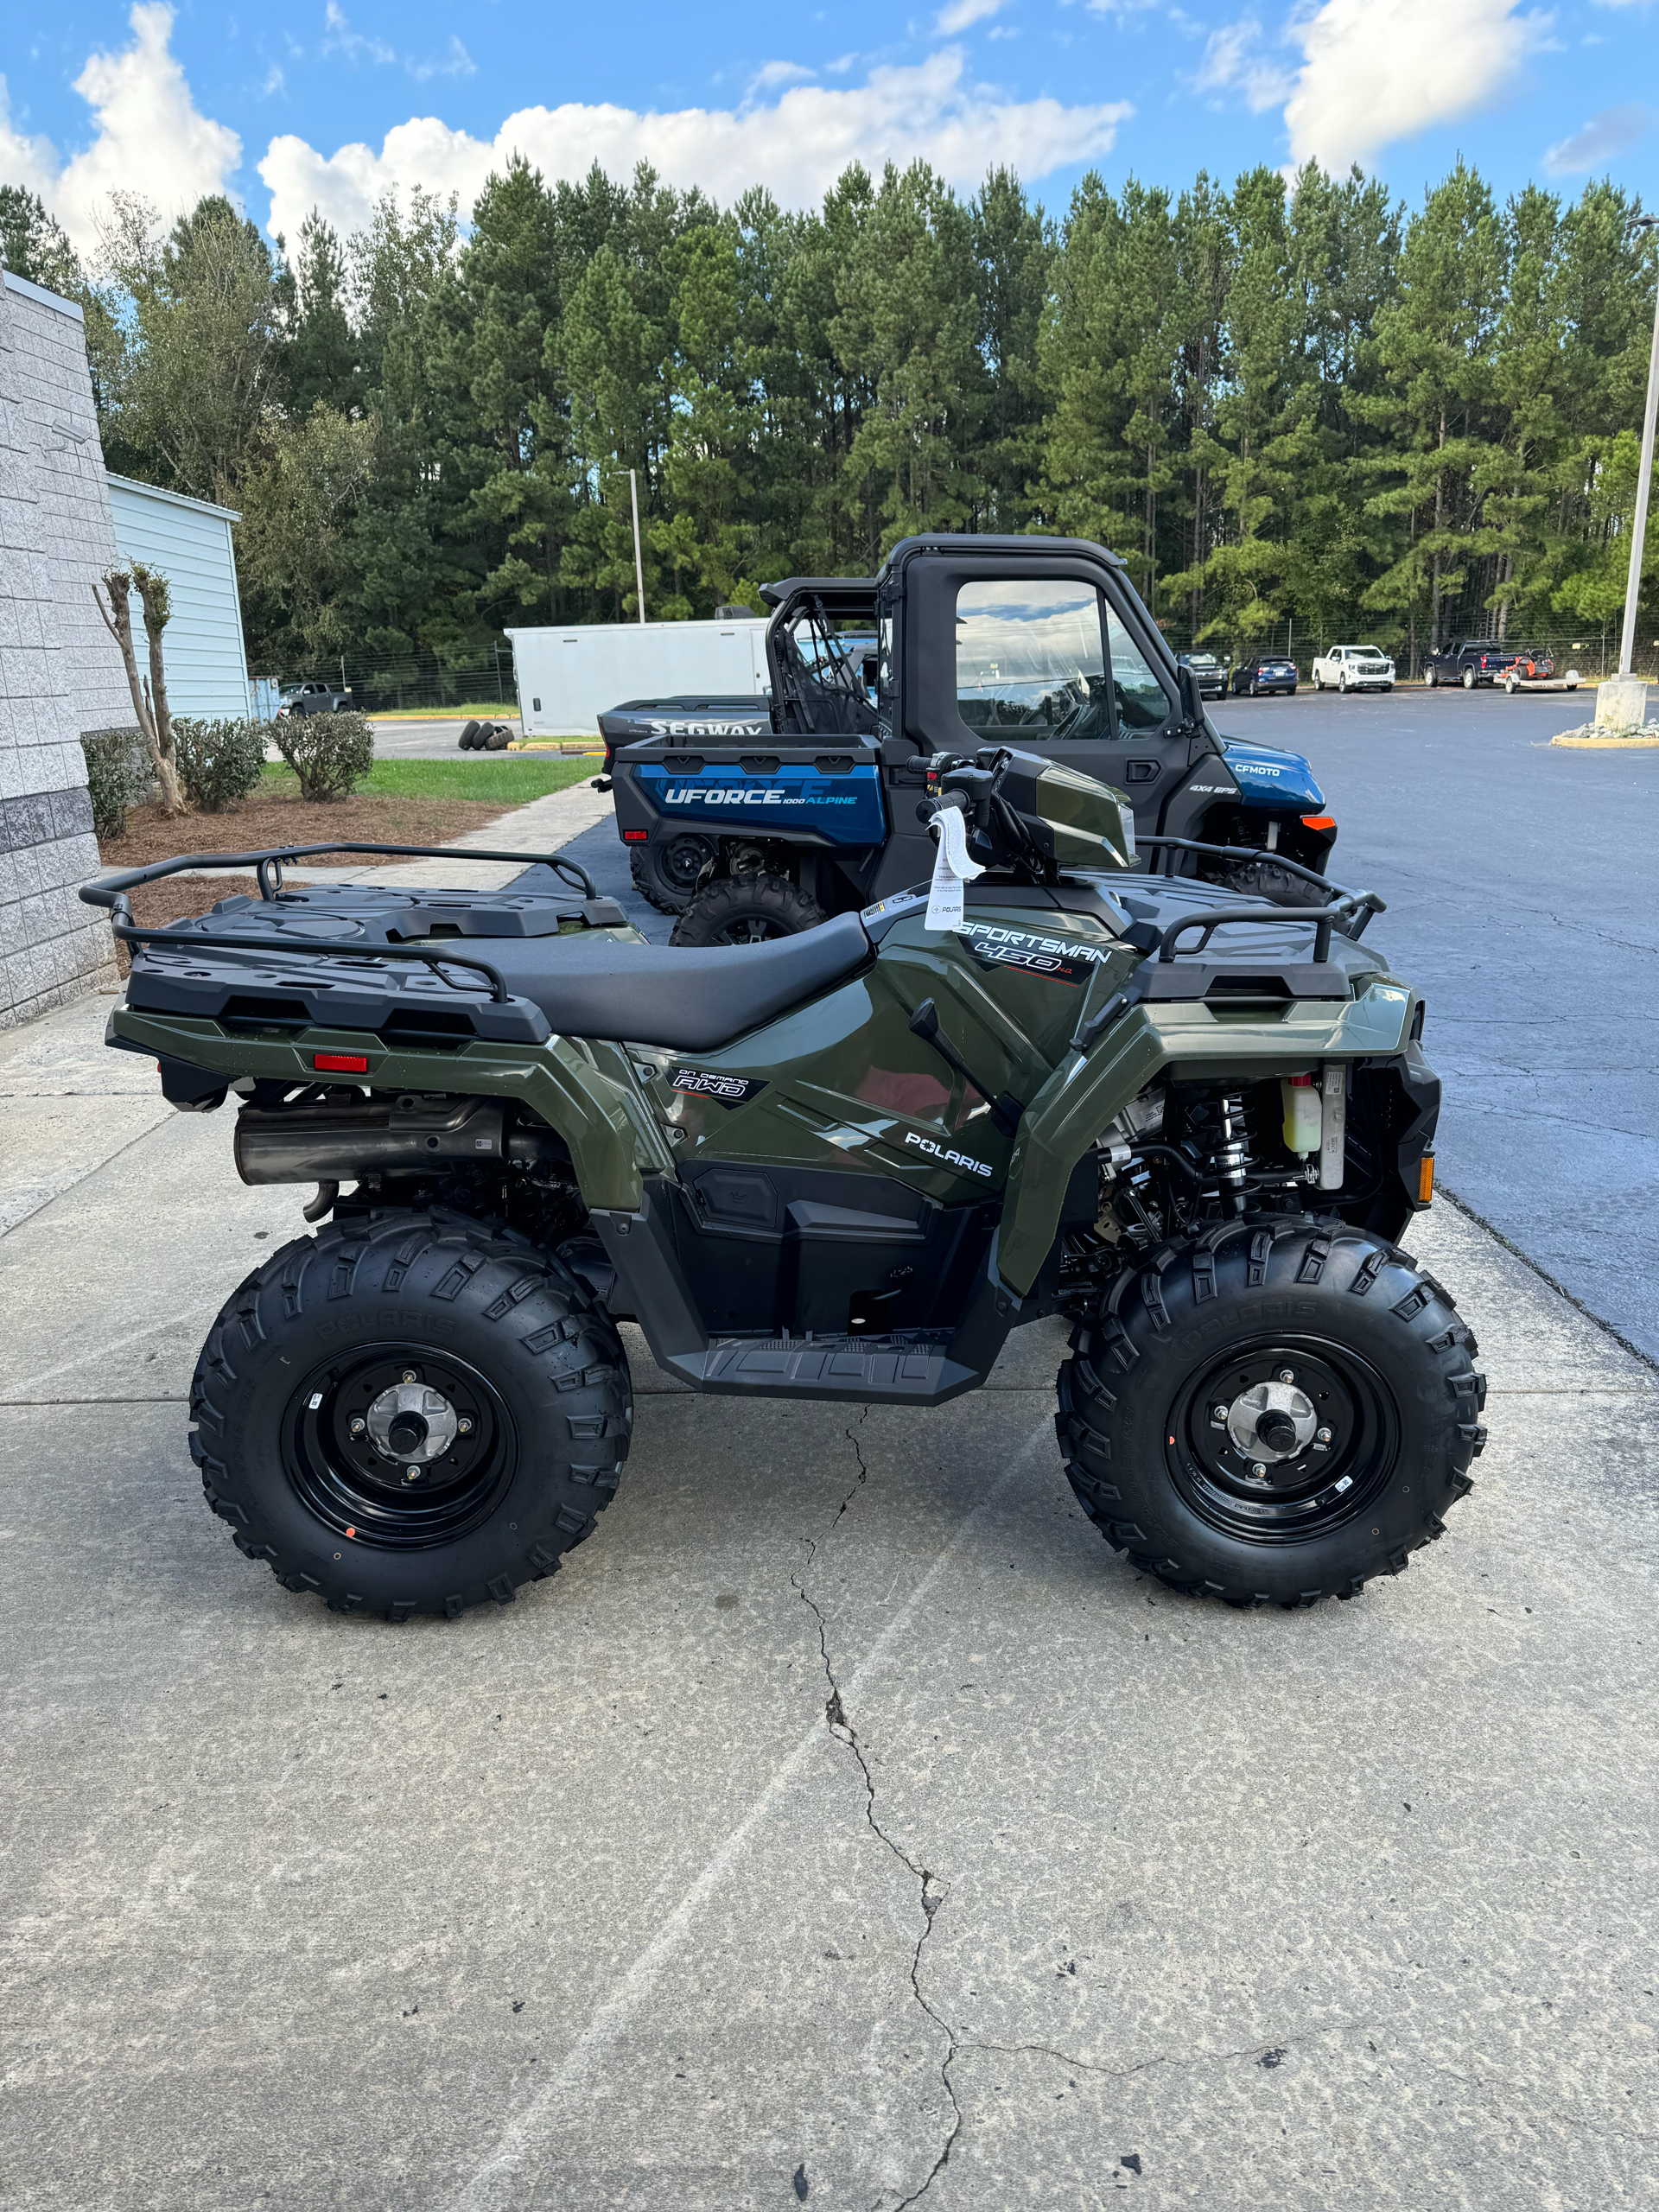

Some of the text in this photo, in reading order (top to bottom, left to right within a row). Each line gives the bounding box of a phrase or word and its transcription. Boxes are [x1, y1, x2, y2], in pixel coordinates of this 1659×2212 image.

[651, 721, 762, 734] SEGWAY
[1235, 764, 1281, 777] CFMOTO
[664, 789, 785, 804] UFORCE
[1213, 786, 1237, 795] EPS
[952, 921, 1112, 963] SPORTSMAN
[974, 942, 1062, 971] 450
[672, 1076, 746, 1097] AWD
[905, 1132, 994, 1178] POLARIS
[315, 1310, 457, 1342] POLARIS
[1180, 1300, 1318, 1351] POLARIS
